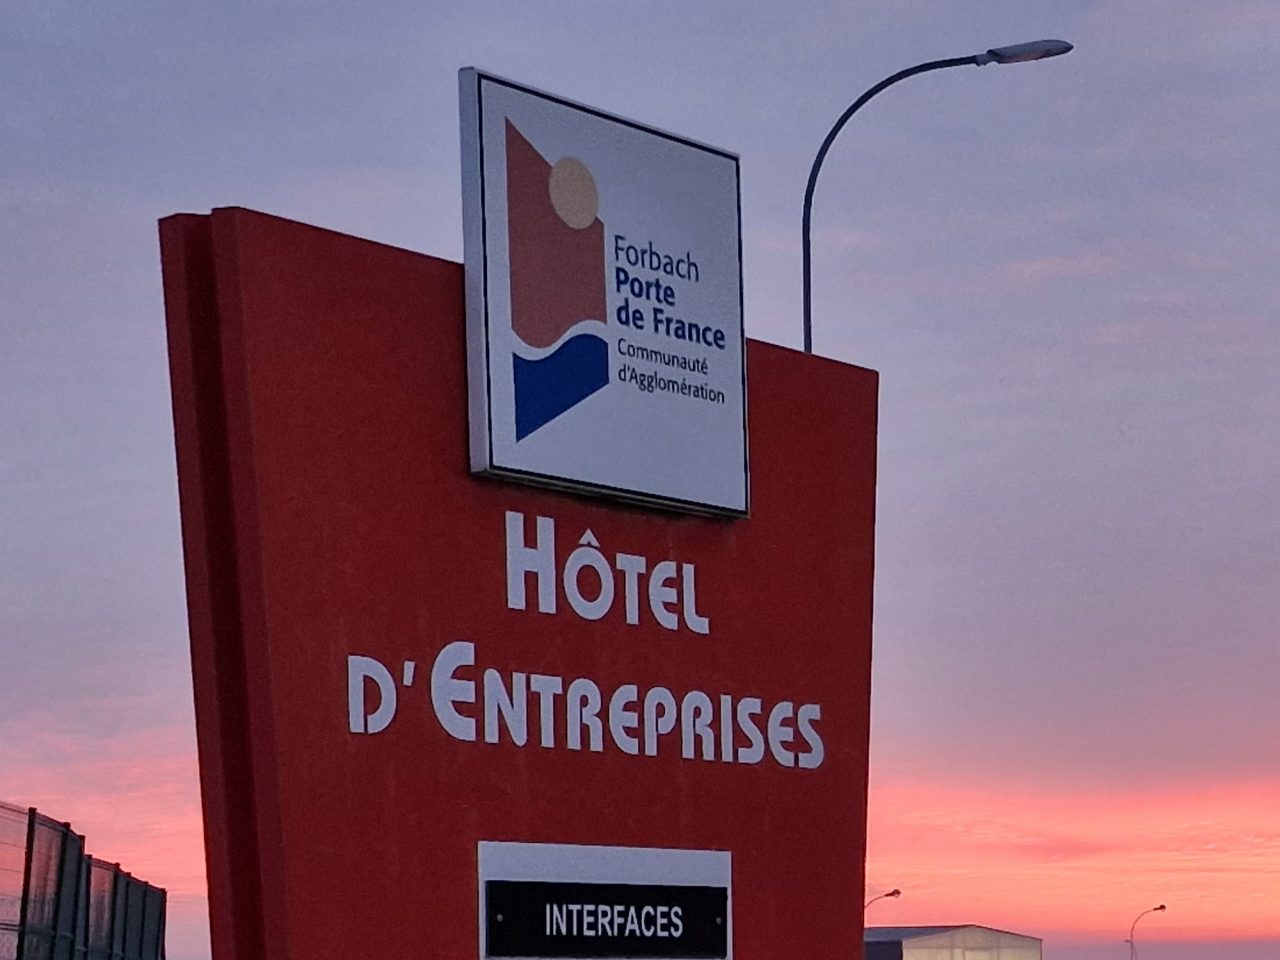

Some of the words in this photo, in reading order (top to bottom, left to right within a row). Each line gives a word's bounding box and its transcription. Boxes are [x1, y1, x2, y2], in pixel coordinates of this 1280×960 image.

[614, 235, 699, 282] Forbach
[615, 267, 675, 306] Porte
[616, 299, 644, 330] de
[653, 309, 726, 349] France
[618, 338, 708, 375] Communauté
[618, 364, 725, 404] d'Agglomération
[505, 510, 710, 635] HÔTEL
[546, 904, 683, 937] INTERFACES
